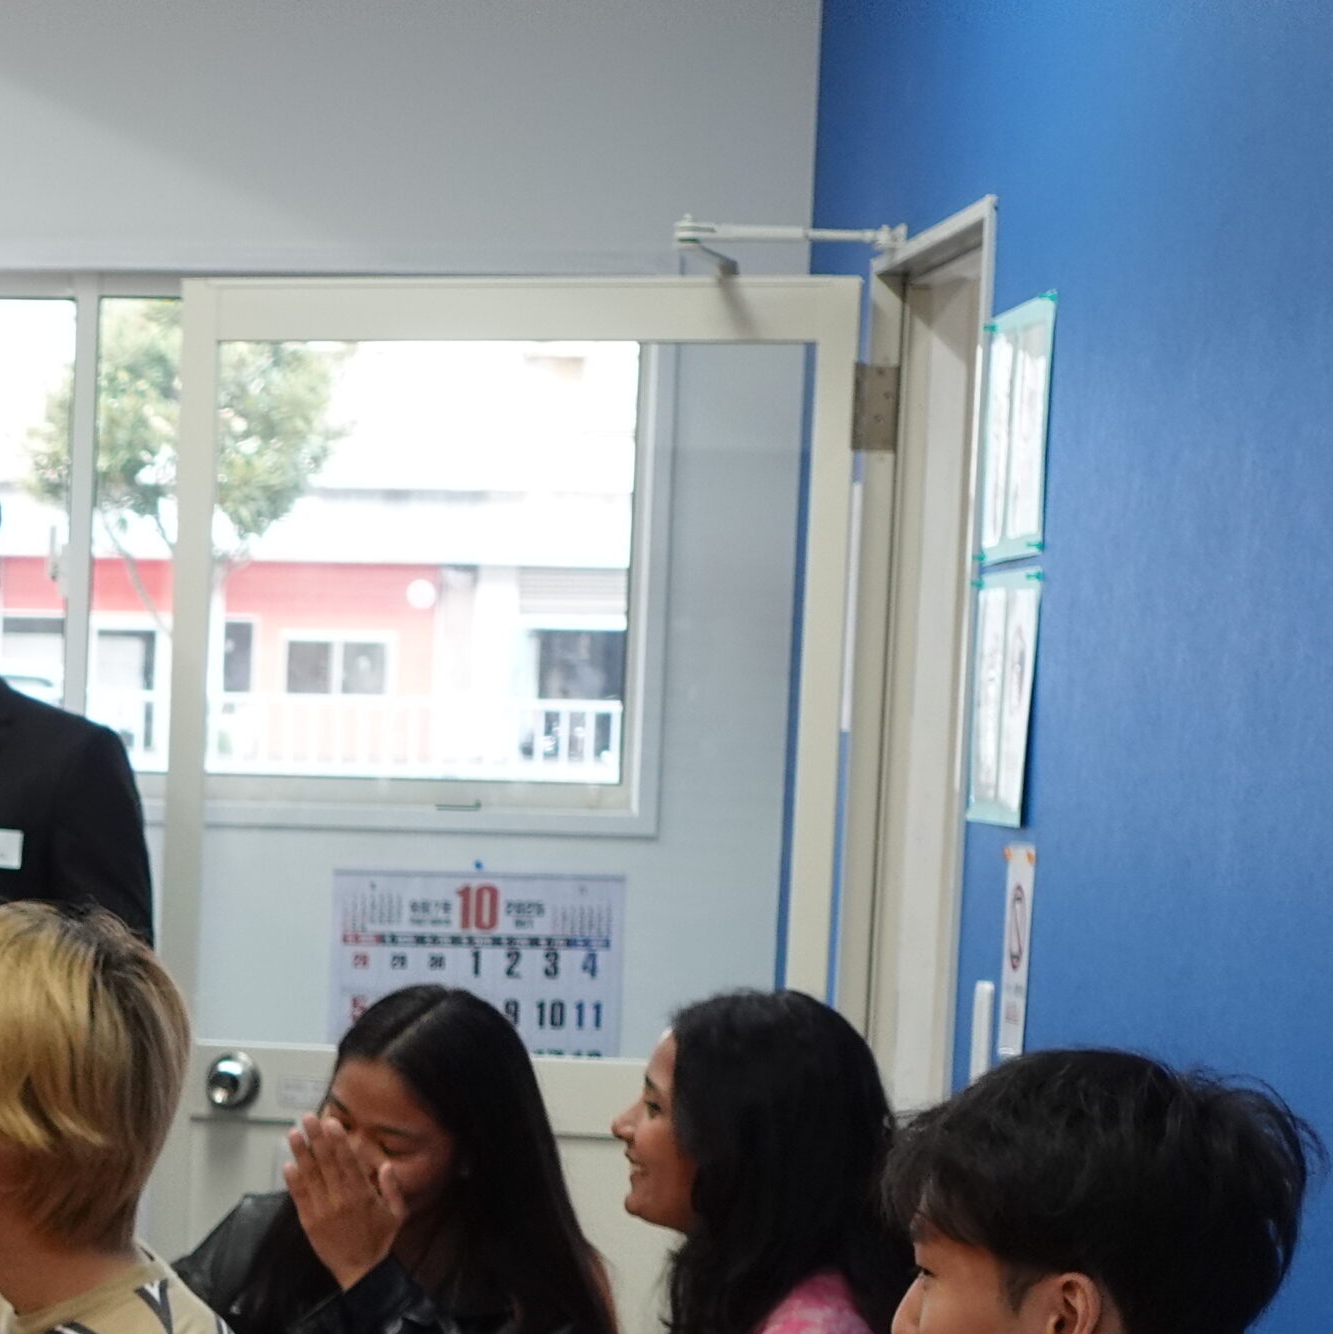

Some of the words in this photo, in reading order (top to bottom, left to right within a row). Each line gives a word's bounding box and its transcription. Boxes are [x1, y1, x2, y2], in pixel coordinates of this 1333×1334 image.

[456, 885, 499, 931] 10
[471, 950, 482, 977] 1
[505, 950, 521, 978] 2
[544, 950, 560, 978] 3
[582, 951, 598, 979] 4
[536, 999, 566, 1030] 10
[575, 999, 603, 1030] 11
